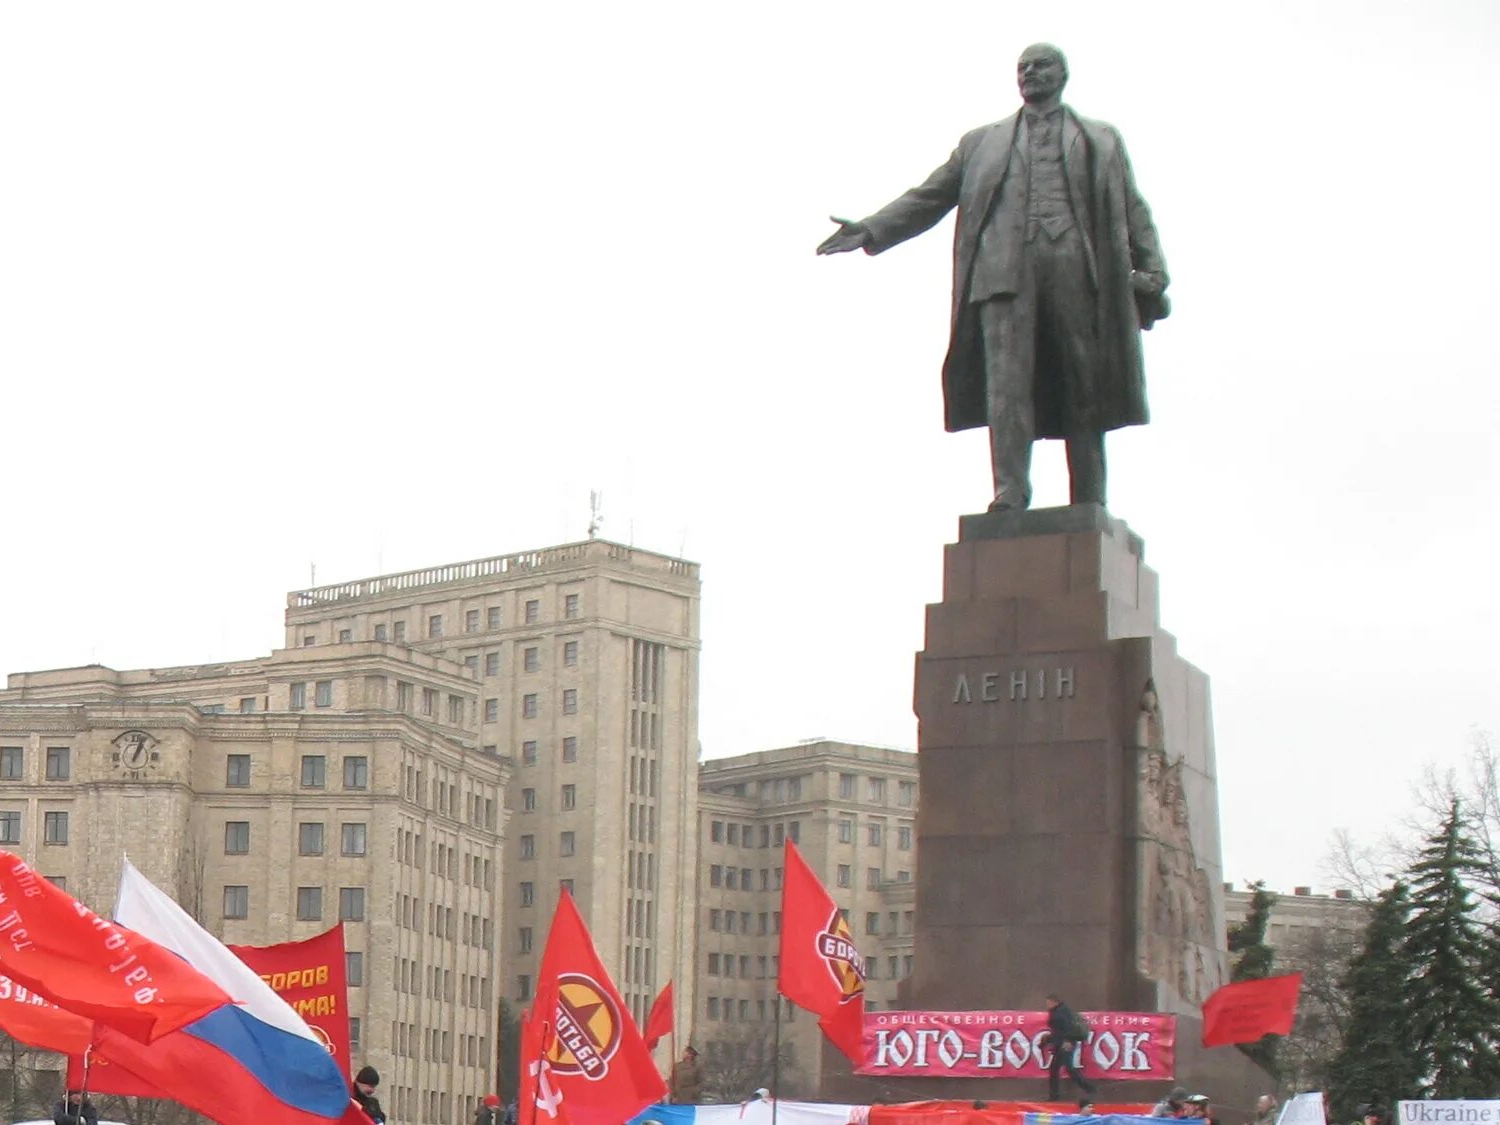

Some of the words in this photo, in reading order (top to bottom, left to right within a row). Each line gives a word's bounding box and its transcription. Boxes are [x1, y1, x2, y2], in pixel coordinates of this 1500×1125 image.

[293, 994, 336, 1017] МА!
[877, 1014, 1026, 1026] ОБЩЕСТВЕННОЕ
[1404, 1103, 1491, 1122] Ukraine
